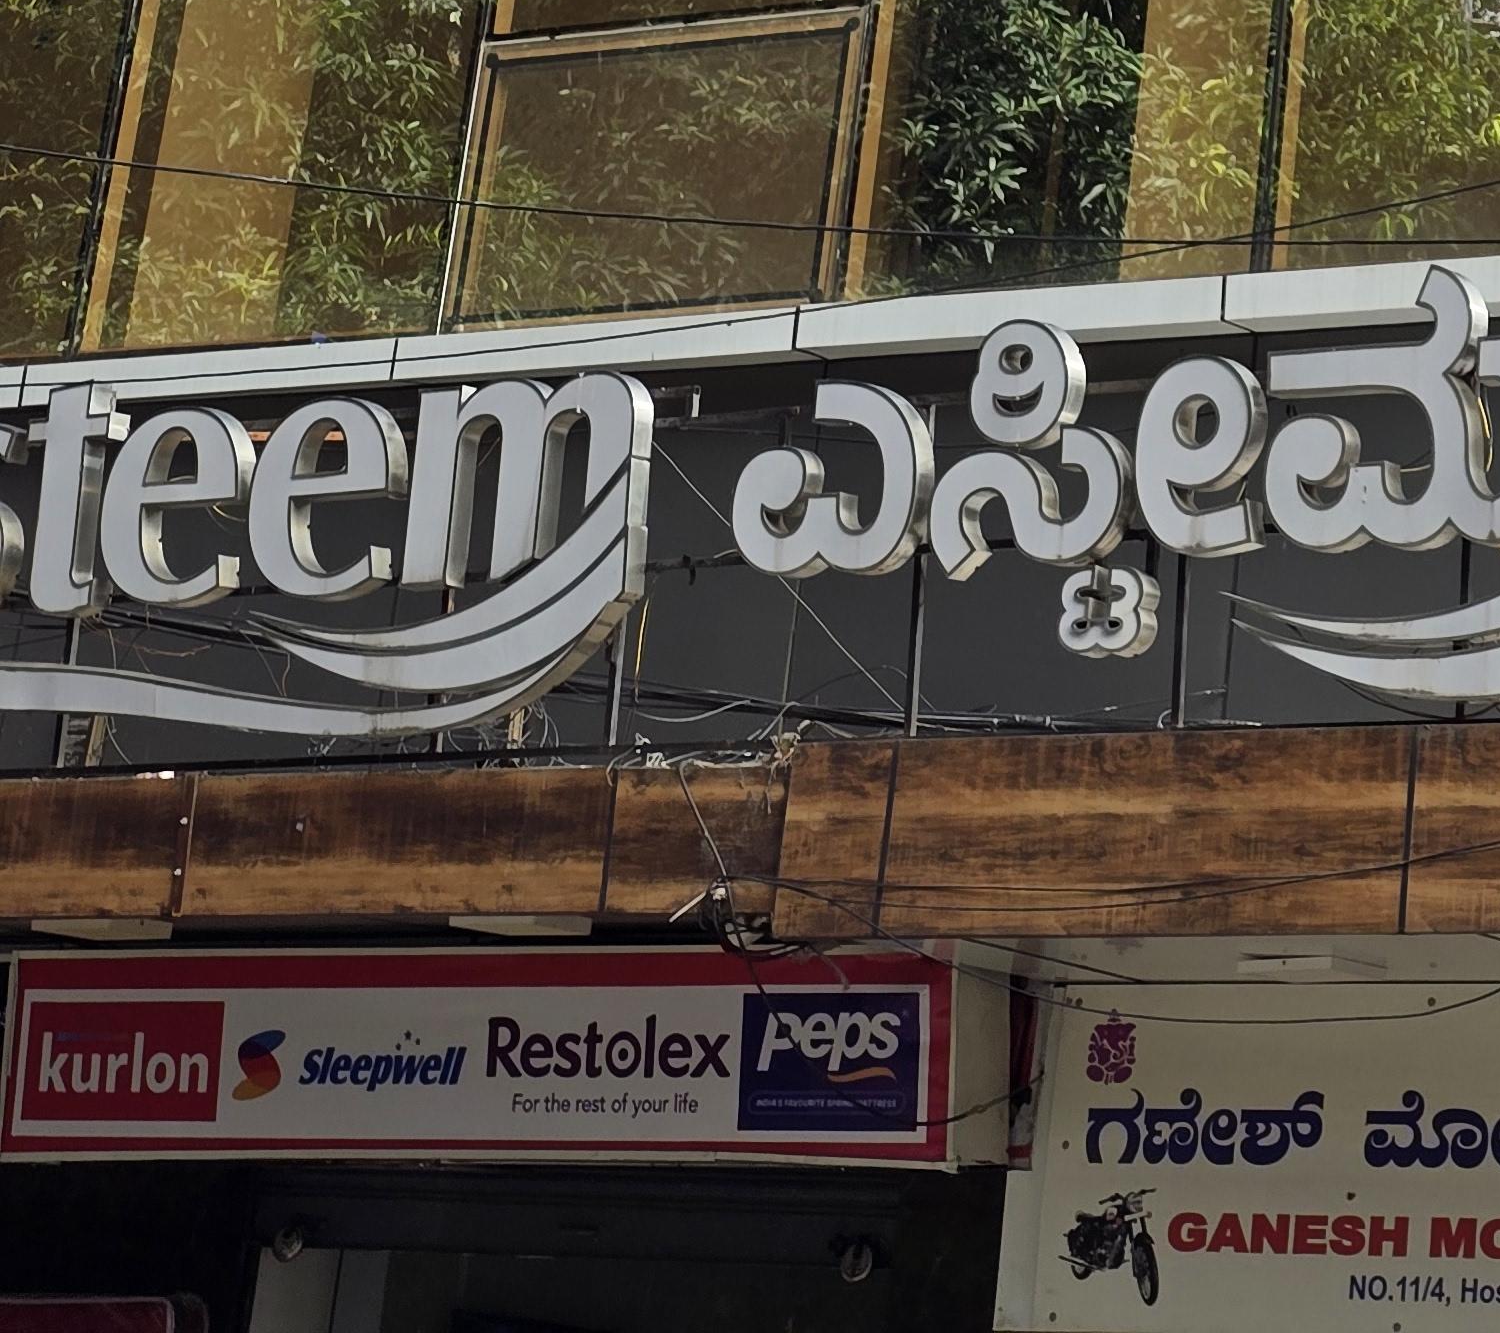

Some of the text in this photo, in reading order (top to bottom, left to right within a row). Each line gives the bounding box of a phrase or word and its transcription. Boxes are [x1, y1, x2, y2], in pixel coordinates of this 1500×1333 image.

[0, 371, 654, 621] teem
[38, 1031, 209, 1094] kurlon
[298, 1046, 468, 1092] Sleepwell
[485, 1013, 731, 1079] Restolex
[511, 1092, 699, 1119] For the rest of your life
[1085, 1087, 1325, 1166] ಗಣೇಶ್
[1167, 1212, 1410, 1258] GANESH
[1348, 1274, 1451, 1307] NO.11/4,
